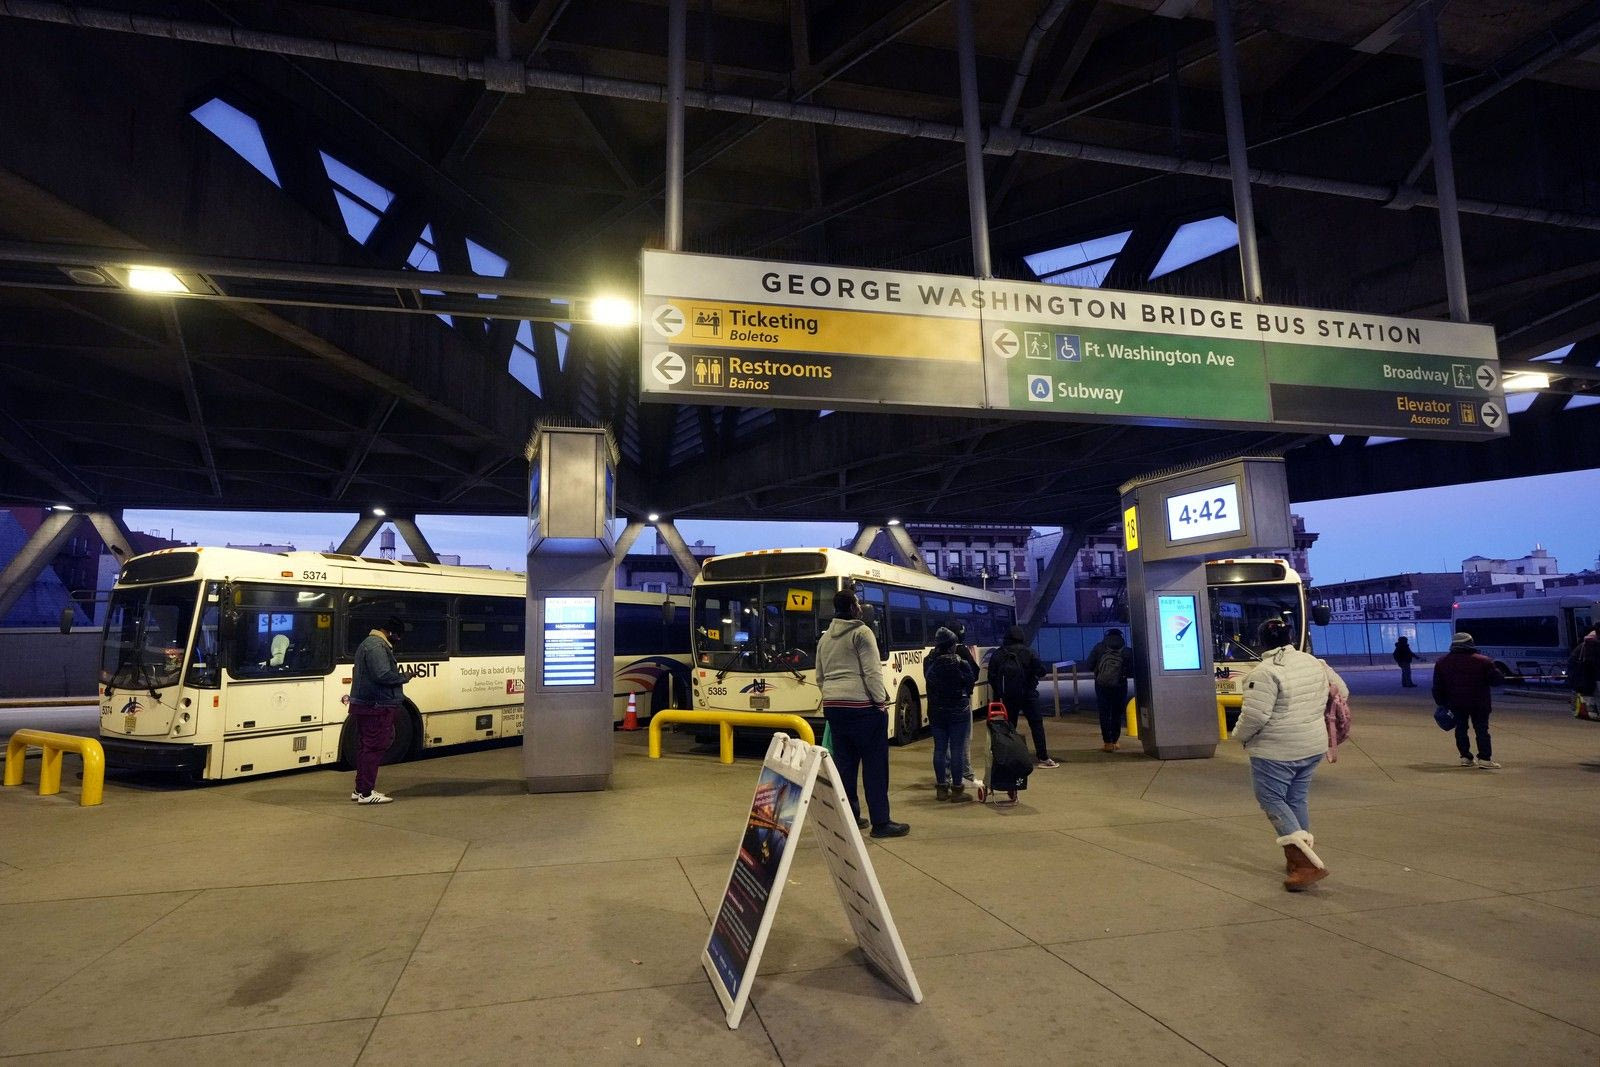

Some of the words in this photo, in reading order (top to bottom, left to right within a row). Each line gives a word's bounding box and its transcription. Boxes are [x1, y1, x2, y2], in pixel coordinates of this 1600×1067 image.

[761, 272, 901, 303] GEORGE
[917, 284, 1126, 321] WASHINGTON
[1141, 303, 1243, 330] BRIDGE
[1257, 314, 1305, 335] BUS
[1318, 319, 1421, 345] STATION
[729, 310, 818, 335] Ticketing
[730, 329, 780, 343] Boletos
[1084, 341, 1105, 358] Ft.
[1107, 343, 1202, 367] Washington
[1206, 351, 1236, 366] Ave
[729, 357, 833, 379] Restrooms
[1383, 364, 1450, 386] Broadway
[729, 377, 770, 390] Baños
[1035, 382, 1046, 395] A
[1057, 382, 1124, 404] Subway
[1396, 396, 1452, 413] Elevator
[1410, 413, 1451, 425] Ascensor
[1178, 498, 1227, 525] 4:42
[1127, 518, 1136, 539] 18
[303, 570, 327, 580] 5374
[900, 651, 923, 665] TRANSIT
[460, 668, 480, 676] Today
[708, 687, 728, 696] 5385
